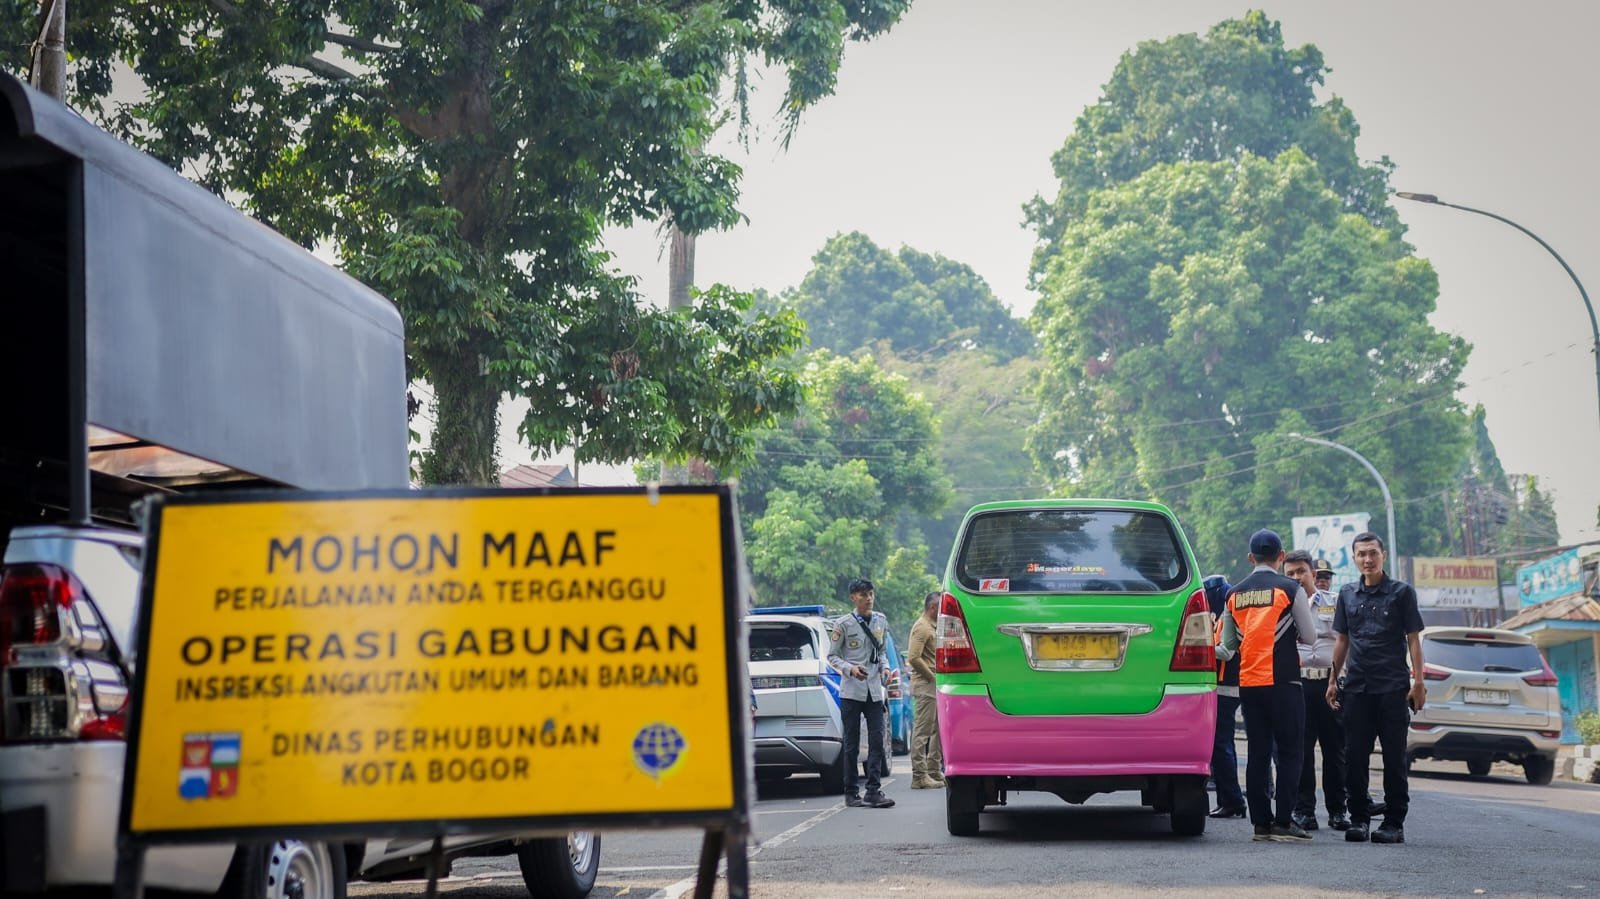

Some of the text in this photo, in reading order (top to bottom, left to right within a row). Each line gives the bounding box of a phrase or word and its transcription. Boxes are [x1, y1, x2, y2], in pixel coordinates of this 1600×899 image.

[266, 530, 617, 575] MOHON MAAF
[213, 577, 667, 612] PERJALANAN ANDA TERGANGGU
[1236, 590, 1272, 609] DISHUB
[180, 624, 699, 667] OPERASI GABUNGAN
[174, 661, 700, 702] INSPEKSI ANGKUTAN UMUM DAN BARANG
[271, 722, 601, 758] DINAS PERHUBUNGAN
[341, 755, 531, 787] KOTA BOGOR
